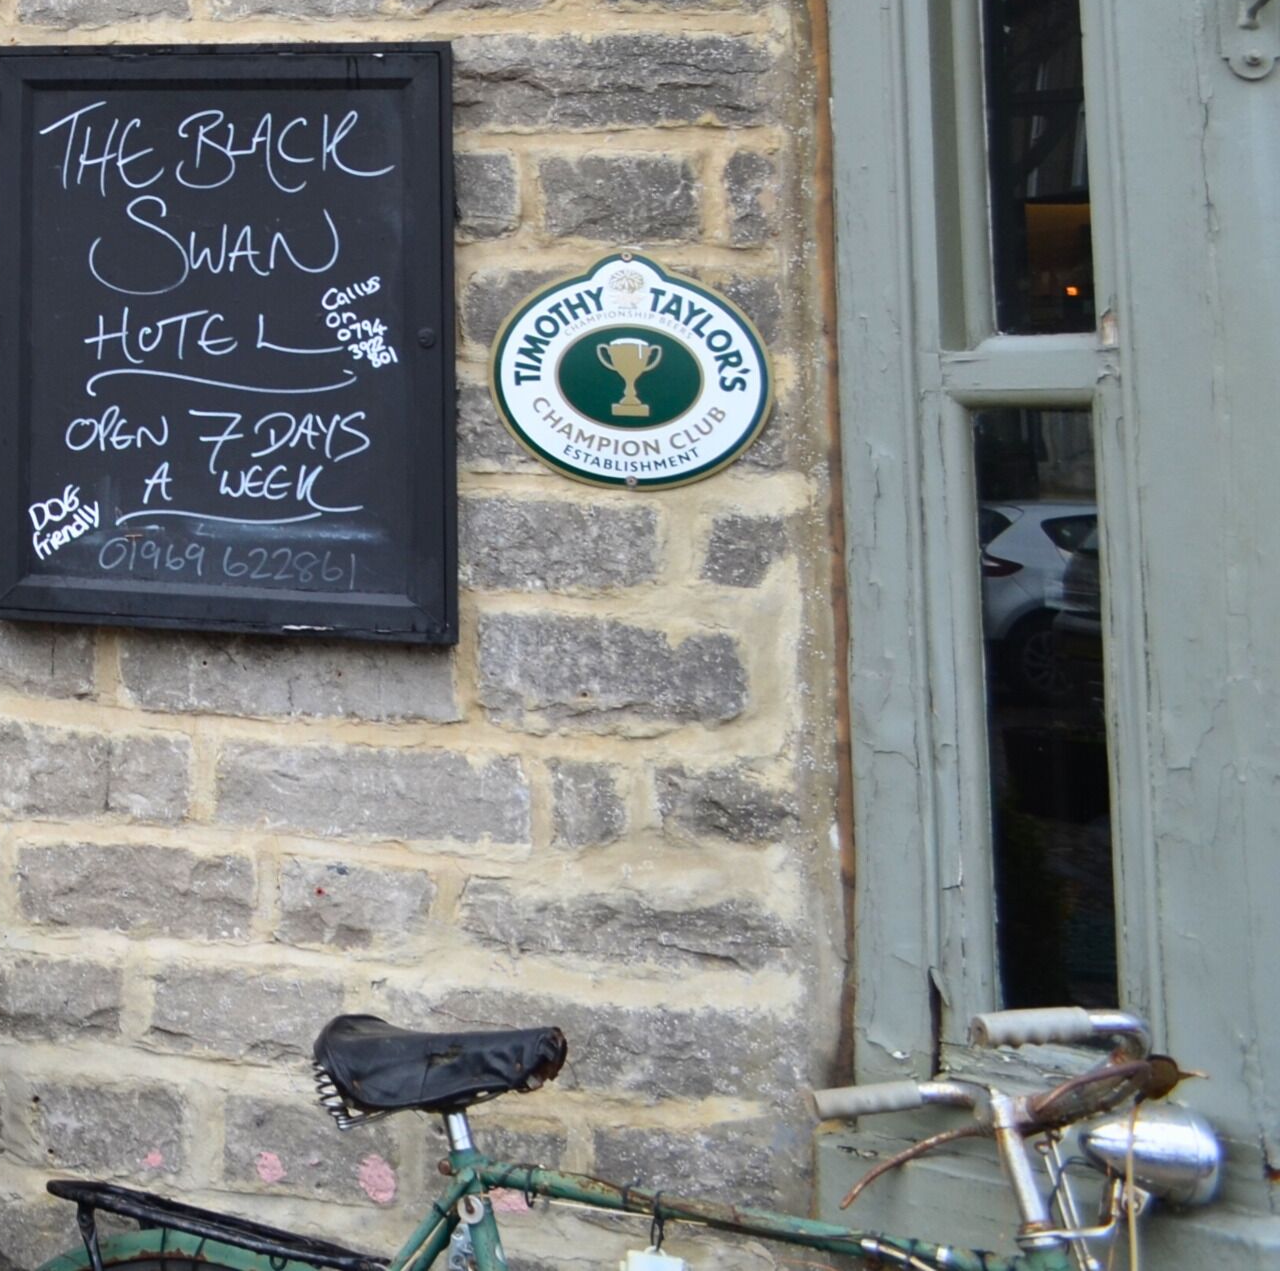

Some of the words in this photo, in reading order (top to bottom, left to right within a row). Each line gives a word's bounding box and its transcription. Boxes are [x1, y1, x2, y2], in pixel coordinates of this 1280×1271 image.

[40, 101, 164, 196] THE
[176, 109, 395, 193] BLACK
[89, 195, 340, 295] SWAN
[84, 306, 344, 364] HOTEL
[337, 318, 388, 342] 0794
[514, 286, 605, 386] TIMOTHY
[649, 287, 752, 393] TAYLOR'S
[564, 309, 655, 337] CHAMPIONSHIP
[65, 406, 169, 451] OPEN
[189, 409, 244, 475] 7
[251, 412, 370, 463] DAYS
[532, 396, 661, 457] CHAMPION
[669, 405, 727, 450] CLUB
[562, 444, 700, 473] ESTABLISHMENT
[28, 484, 81, 531] DOG
[143, 462, 174, 505] A
[219, 465, 365, 513] WEEK
[98, 536, 206, 577] 01969
[223, 546, 357, 591] 622861
